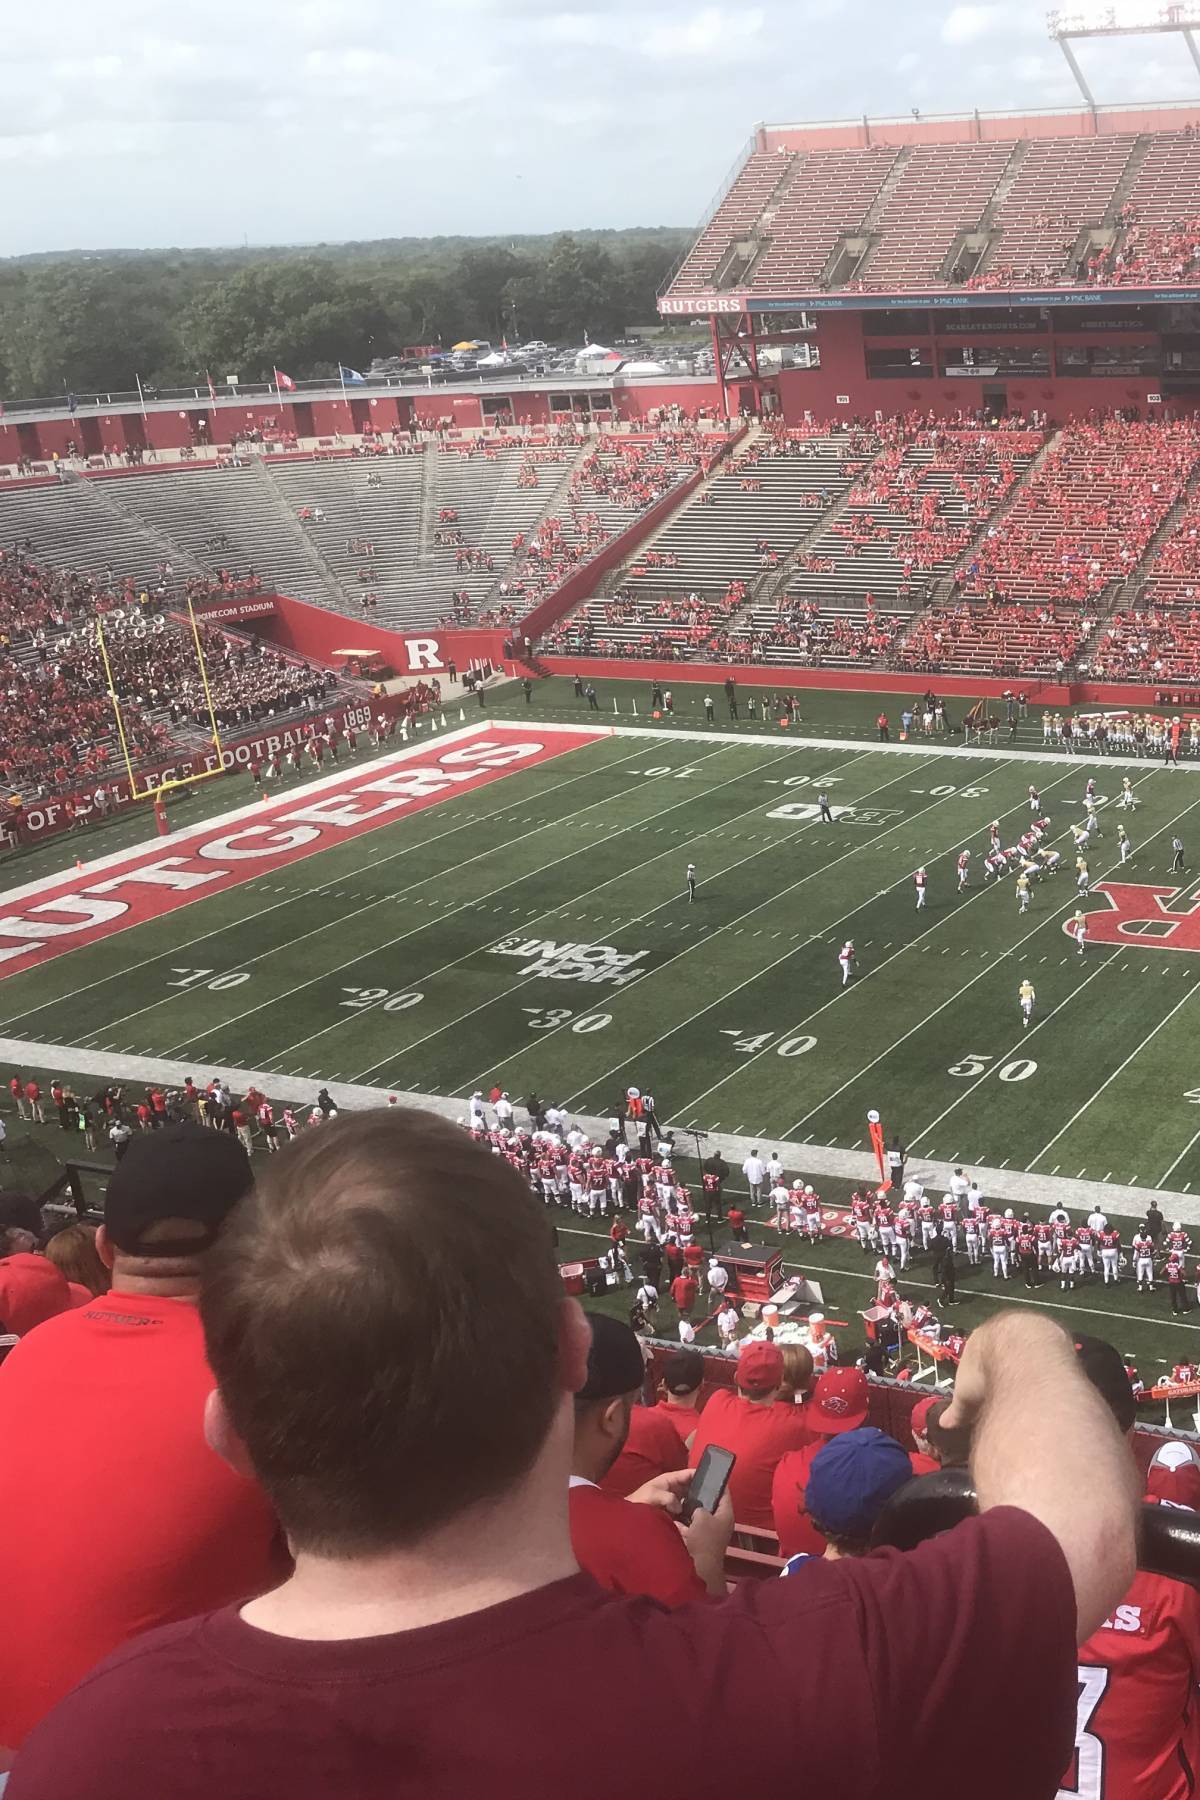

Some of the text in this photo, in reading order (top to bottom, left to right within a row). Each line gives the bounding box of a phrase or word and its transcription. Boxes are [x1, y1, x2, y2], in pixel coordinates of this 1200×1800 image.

[661, 298, 741, 315] RUTGERS
[239, 602, 274, 614] STADIUM
[404, 638, 444, 669] R
[27, 805, 61, 836] OF
[342, 706, 371, 731] 1869
[643, 766, 703, 778] 10
[784, 776, 845, 788] 20
[930, 785, 990, 798] 30
[0, 741, 544, 963] UTGERS
[166, 968, 251, 990] 10
[516, 958, 645, 985] HIGH
[338, 988, 425, 1011] 20
[528, 1008, 613, 1034] 30
[733, 1031, 818, 1057] 40
[948, 1054, 1038, 1082] 50
